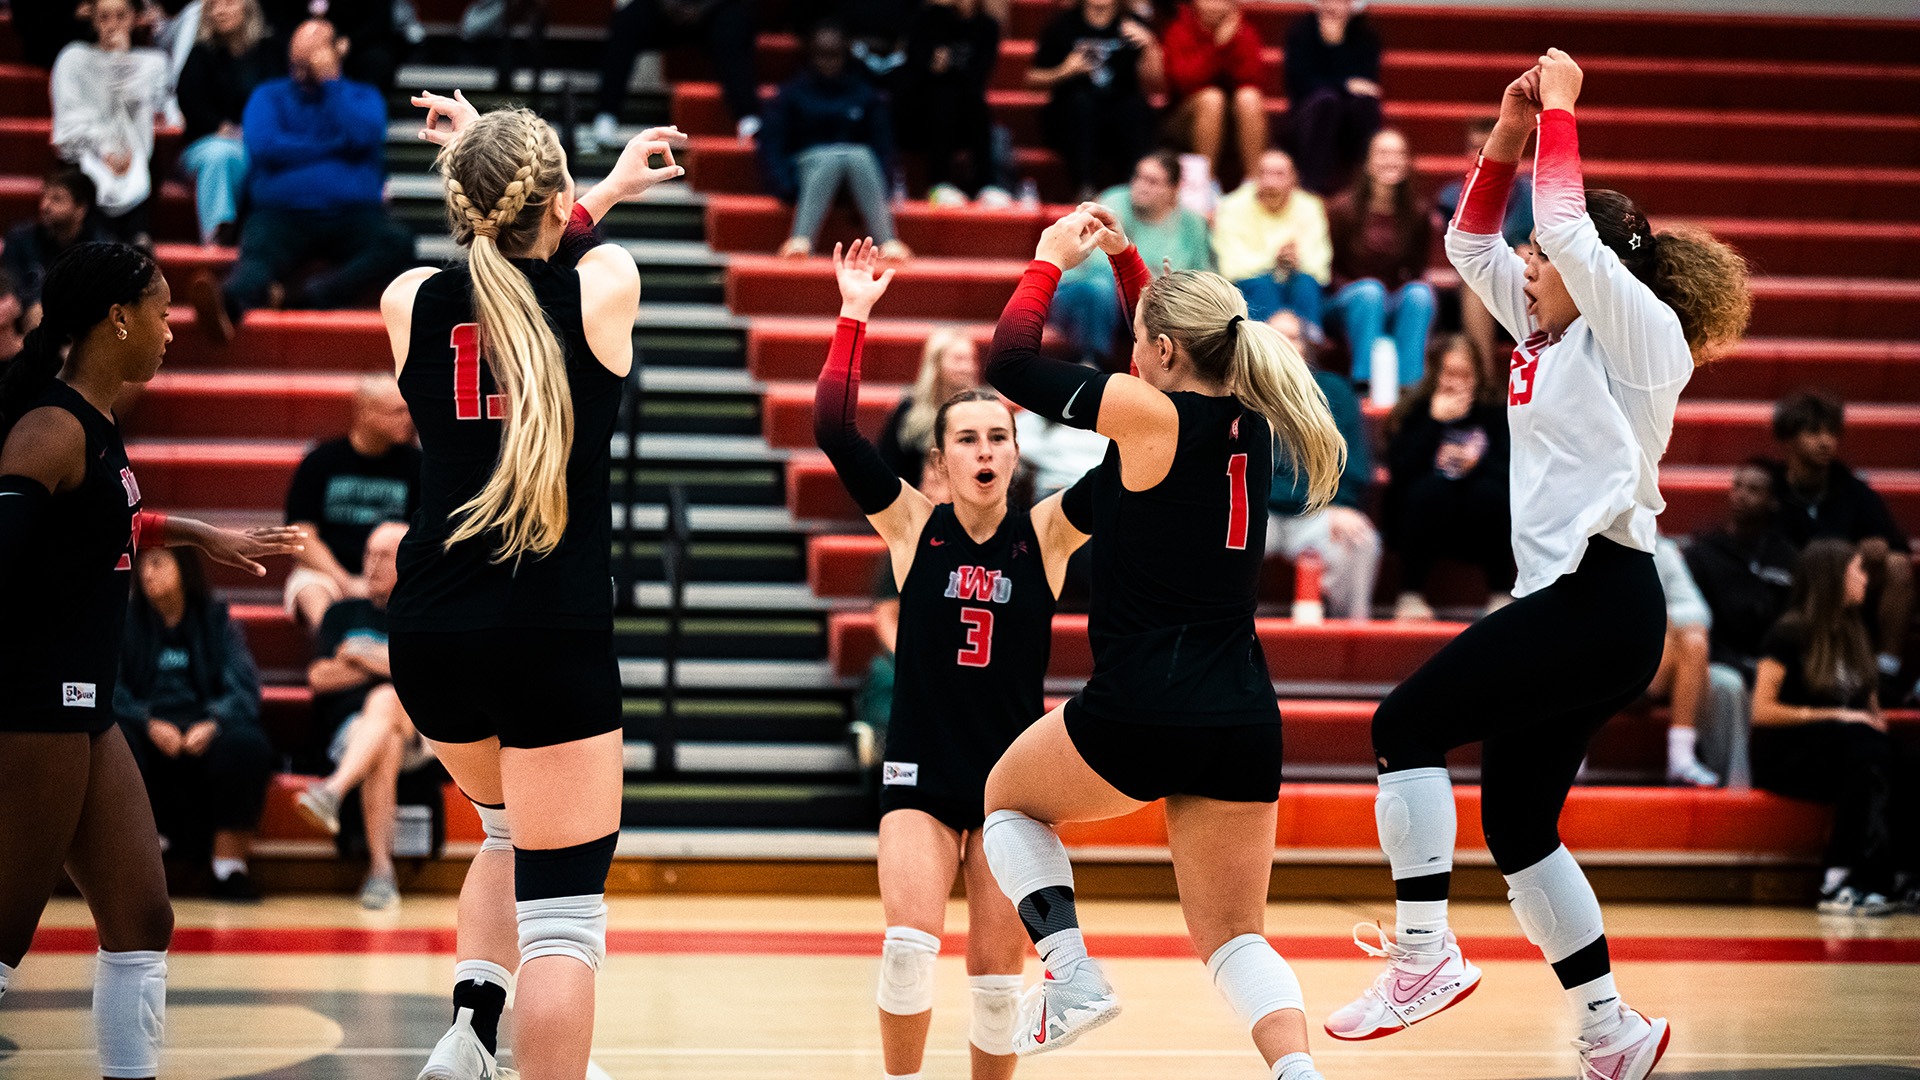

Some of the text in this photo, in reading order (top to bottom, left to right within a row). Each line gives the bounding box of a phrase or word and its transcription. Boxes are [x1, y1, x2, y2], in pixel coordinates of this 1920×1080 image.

[450, 322, 512, 420] 1
[1225, 453, 1249, 550] 1
[944, 565, 1012, 604] IWU
[957, 606, 994, 668] 3
[1403, 1005, 1416, 1015] DO
[1416, 996, 1427, 1006] IT
[1439, 983, 1455, 993] DAD
